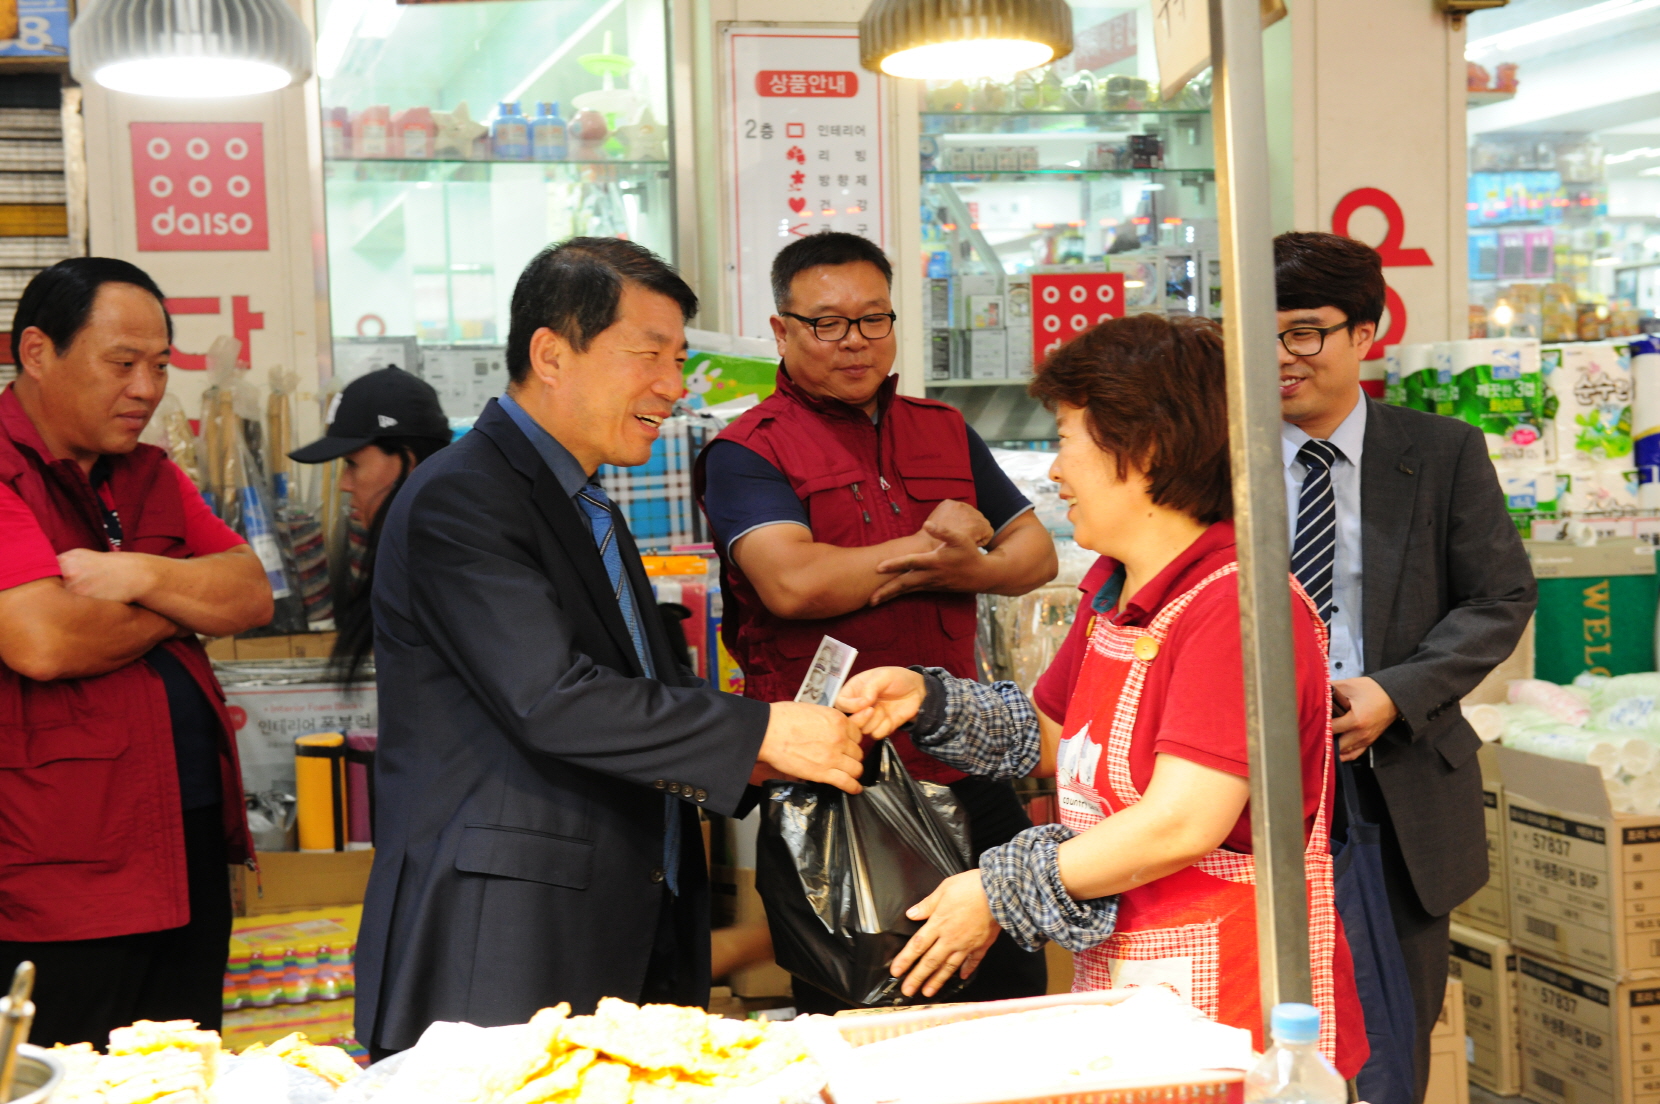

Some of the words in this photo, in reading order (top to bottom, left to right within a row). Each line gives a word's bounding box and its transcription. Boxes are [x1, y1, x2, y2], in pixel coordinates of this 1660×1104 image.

[768, 74, 846, 94] 상품안내
[744, 118, 774, 140] 2층
[818, 124, 867, 138] 인테리어
[151, 205, 253, 236] daiso
[258, 716, 316, 735] 인테리어
[1532, 832, 1571, 857] 57837
